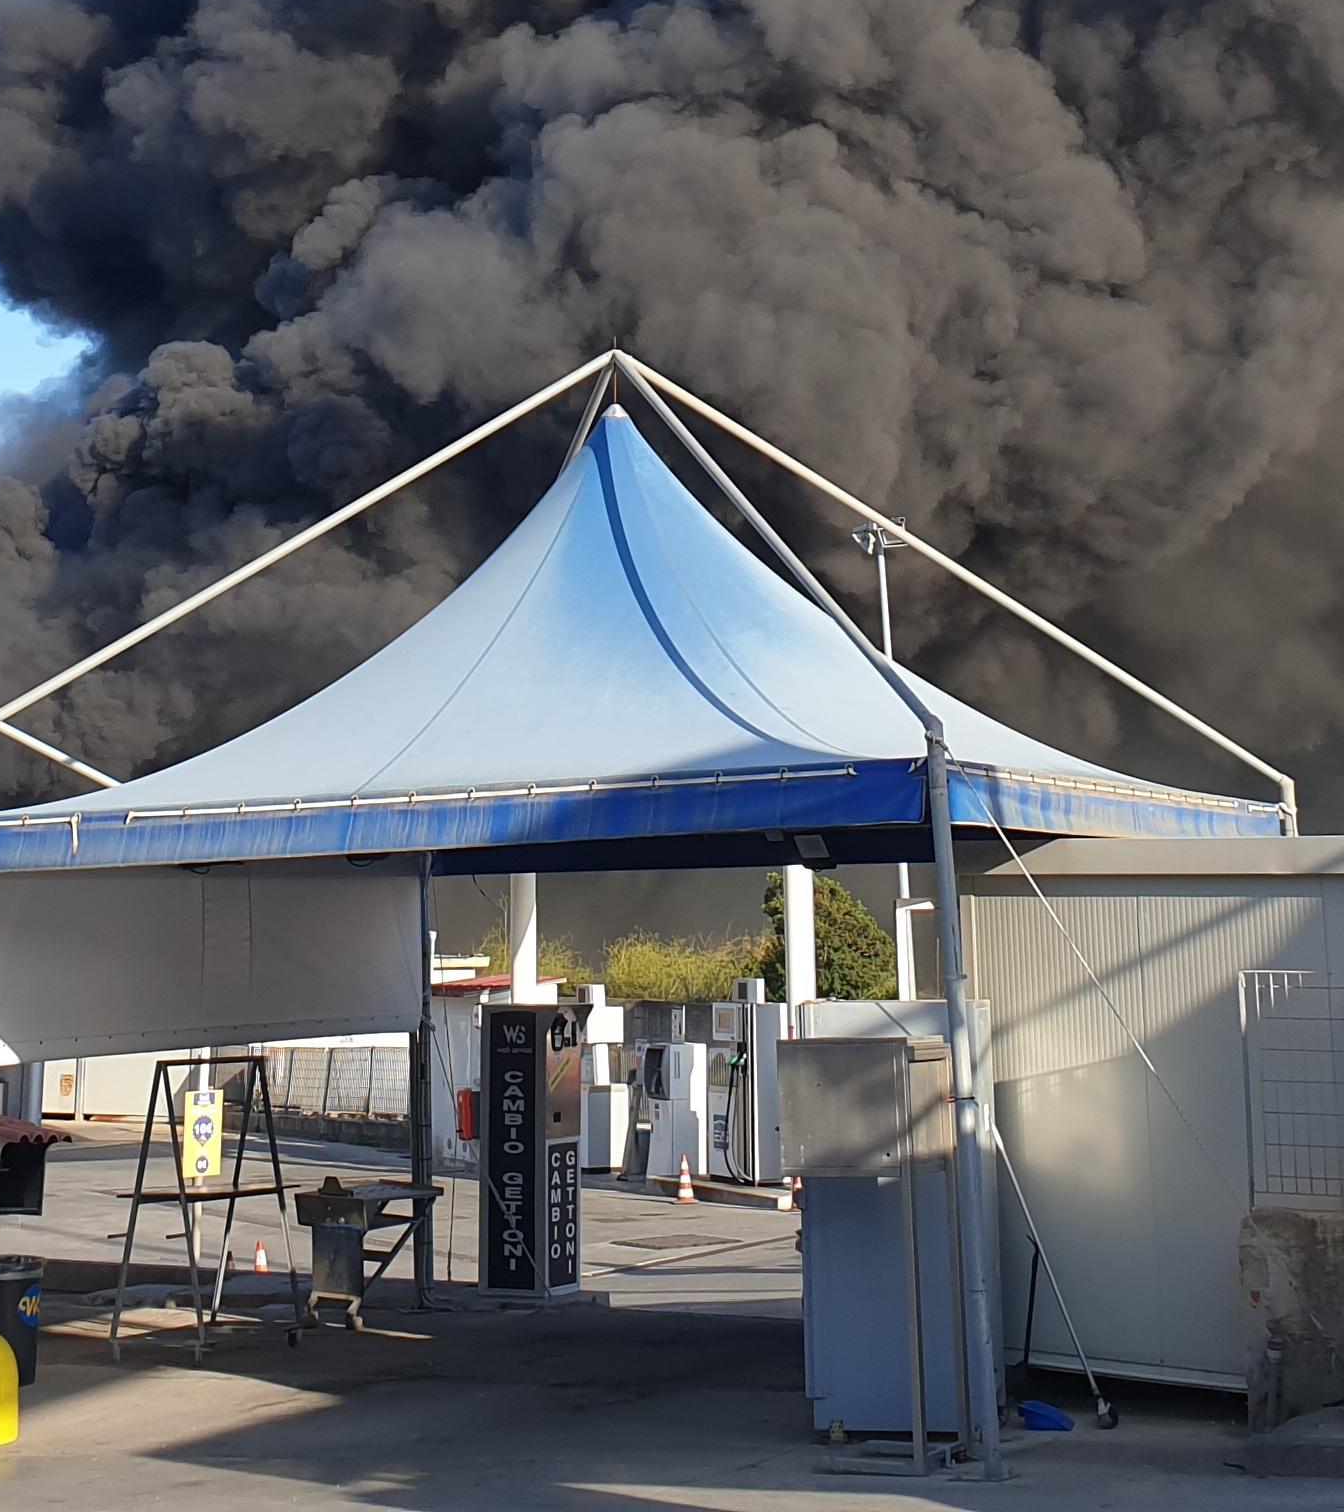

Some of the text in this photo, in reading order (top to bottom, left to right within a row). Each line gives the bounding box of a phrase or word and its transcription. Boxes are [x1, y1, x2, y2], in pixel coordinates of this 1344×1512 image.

[503, 1070, 525, 1154] CAMBIO
[502, 1172, 524, 1271] GETTONI
[551, 1152, 561, 1259] CAMBIO
[566, 1150, 576, 1274] GETTONI
